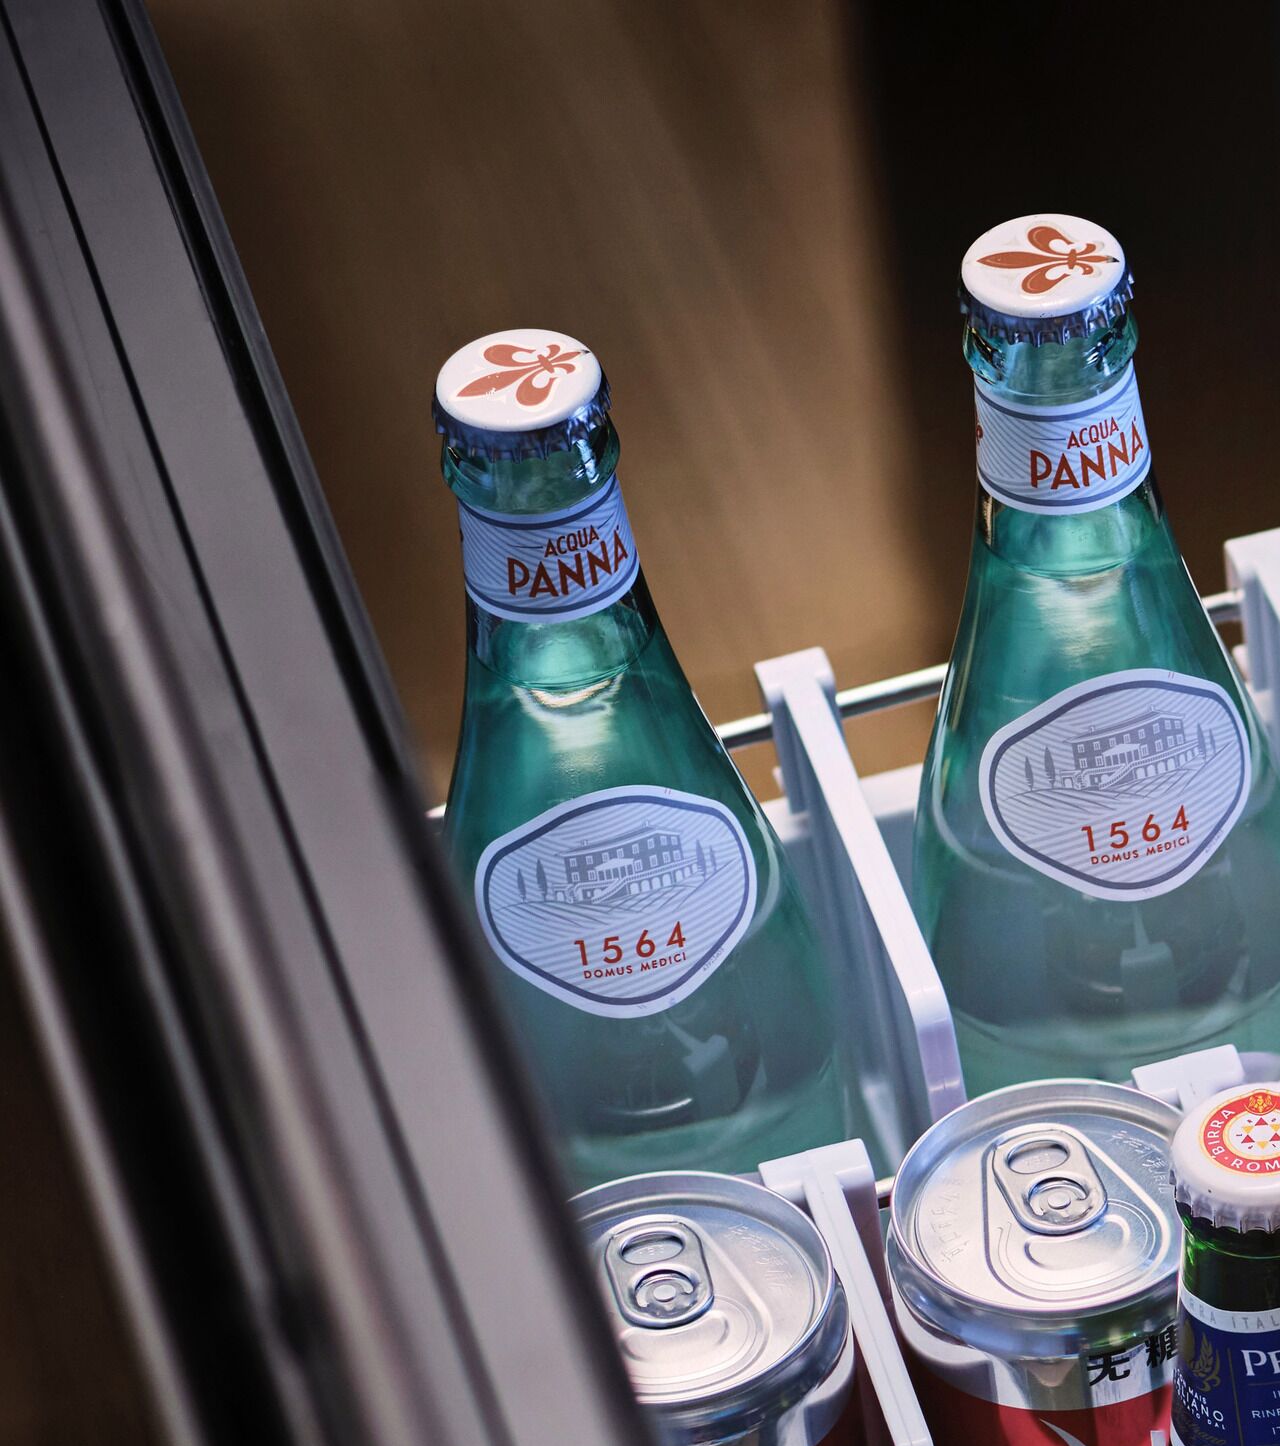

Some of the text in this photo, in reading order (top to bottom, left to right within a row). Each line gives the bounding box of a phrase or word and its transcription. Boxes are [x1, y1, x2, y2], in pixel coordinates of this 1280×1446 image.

[1030, 420, 1144, 489] PANNA
[1067, 416, 1120, 450] ACQUA
[507, 529, 628, 597] PANNA
[544, 525, 599, 557] ACQUA
[1081, 804, 1190, 852] 1564
[1091, 835, 1190, 865] DOMUS MEDICI
[574, 921, 686, 966] 1564
[584, 952, 687, 979] DOMUS MEDICI
[1207, 1109, 1235, 1157] BIRRA
